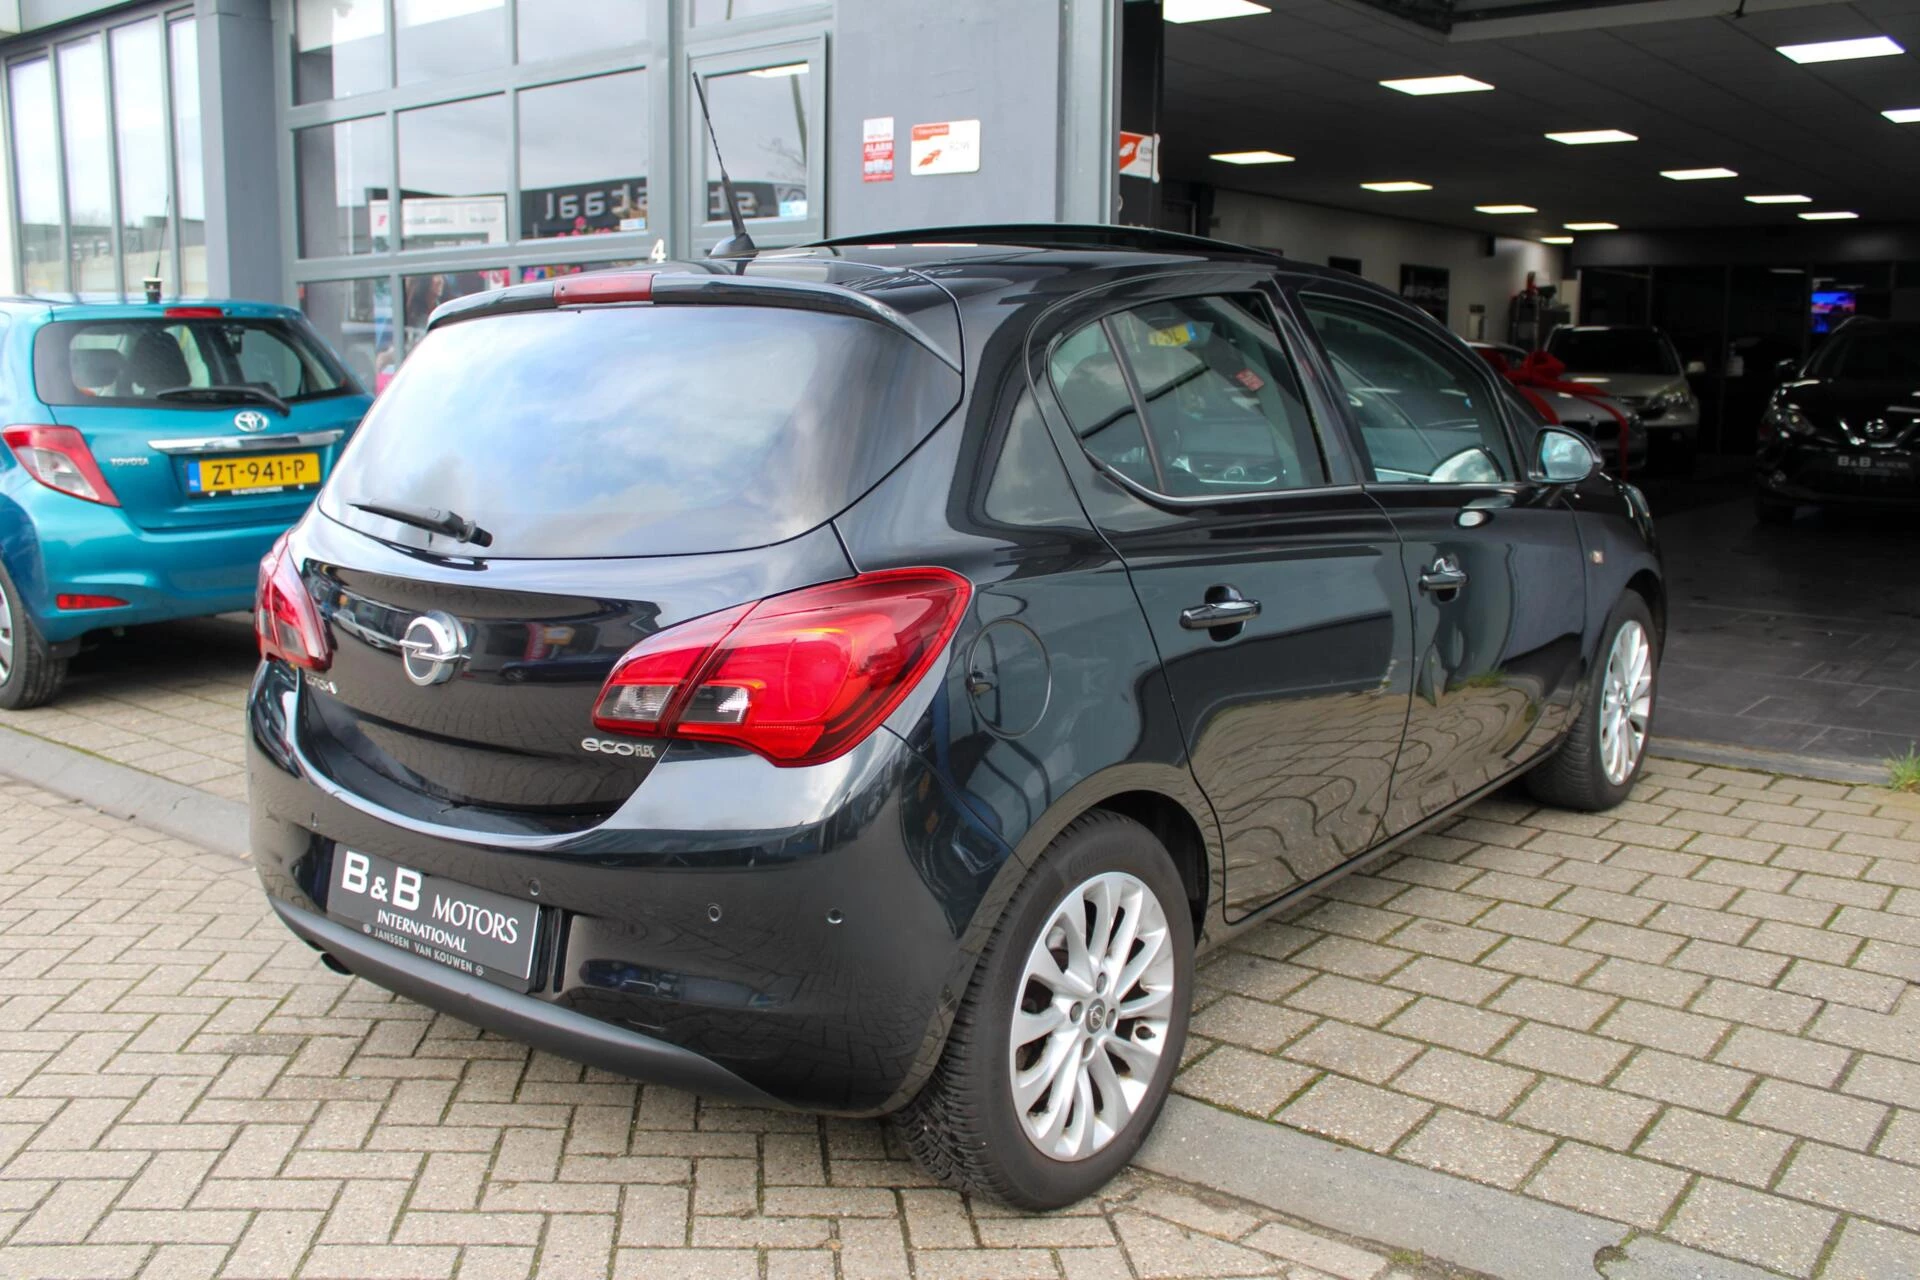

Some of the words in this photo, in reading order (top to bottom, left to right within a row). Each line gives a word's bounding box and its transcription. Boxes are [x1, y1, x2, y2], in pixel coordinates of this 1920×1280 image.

[651, 239, 666, 264] 4
[109, 457, 149, 466] TOYOTA
[211, 459, 305, 486] ZT-941-P
[377, 909, 467, 953] INTERNATIONAL
[432, 894, 519, 944] MOTORS
[374, 928, 410, 949] JANSSEN
[415, 942, 432, 957] VAN
[434, 950, 473, 973] KOUWEN
